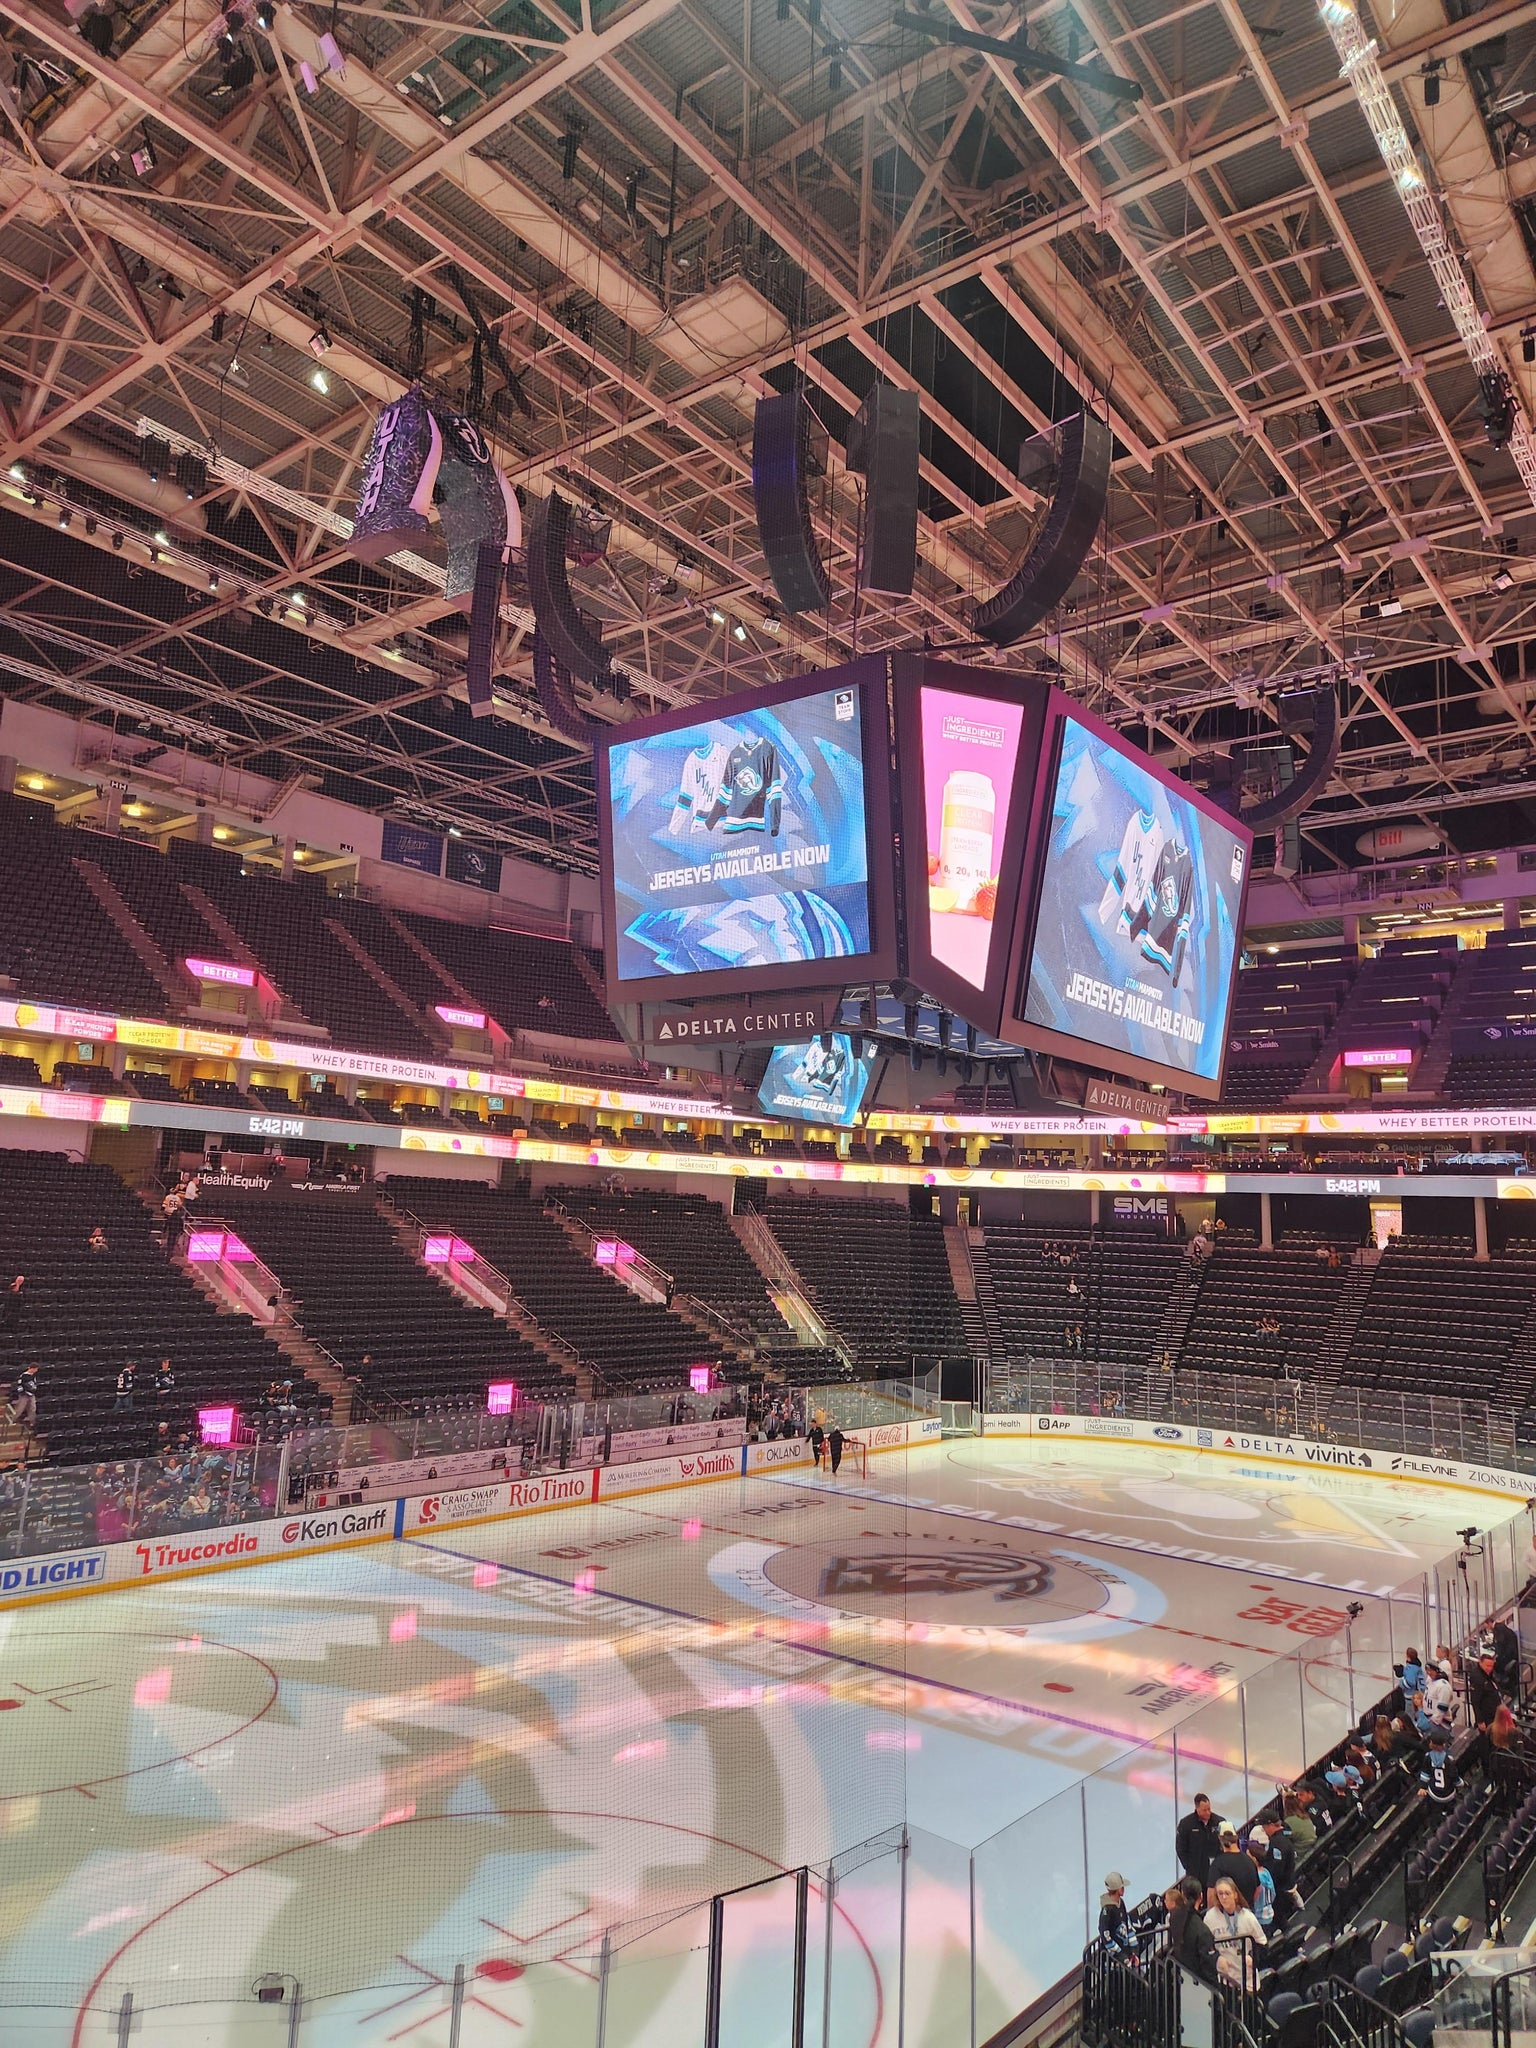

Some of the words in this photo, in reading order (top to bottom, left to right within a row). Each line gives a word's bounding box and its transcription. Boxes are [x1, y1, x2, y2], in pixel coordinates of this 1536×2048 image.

[947, 716, 965, 724] JUST
[946, 724, 1000, 740] INGREDIENTS
[1378, 830, 1402, 846] bill
[710, 851, 728, 861] UTAH
[727, 845, 760, 858] MAMMOTH
[649, 864, 712, 891] JERSEYS
[714, 850, 792, 880] AVAILABLE
[794, 844, 830, 868] NOW
[203, 966, 238, 980] BETTER
[1066, 972, 1124, 1014] JERSEYS
[1122, 989, 1181, 1035] AVAILABLE
[1178, 1016, 1205, 1045] NOW
[448, 1012, 474, 1024] BETTER
[678, 1018, 737, 1036] DELTA
[743, 1010, 816, 1031] CENTER
[312, 1053, 348, 1067] WHEY
[349, 1058, 388, 1074] BETTER
[1363, 1052, 1397, 1062] BETTER
[650, 1100, 676, 1110] WHEY
[678, 1104, 711, 1114] BETTER
[1100, 1090, 1132, 1110] DELTA
[1134, 1099, 1168, 1118] CENTER
[250, 1116, 281, 1134] 5:42
[282, 1120, 304, 1136] PM
[991, 1121, 1022, 1130] WHEY
[1023, 1122, 1060, 1130] BETTER
[1379, 1118, 1418, 1128] WHEY
[1420, 1118, 1468, 1128] BETTER
[678, 1162, 716, 1170] INGREDIENTS
[198, 1172, 272, 1190] HealthEquity
[1026, 1178, 1068, 1186] INGREDIENTS
[1326, 1179, 1359, 1193] 5:42
[1358, 1180, 1380, 1193] PM
[1114, 1198, 1168, 1214] SME
[1087, 1424, 1131, 1432] INGREDIENTS
[1154, 1428, 1182, 1439] Ford
[766, 1444, 800, 1461] OKLAND
[1241, 1438, 1294, 1455] DELTA
[1305, 1445, 1356, 1466] vivint
[696, 1454, 734, 1476] Smith's
[1403, 1461, 1458, 1478] FILEVINE
[1468, 1470, 1506, 1486] ZIONS
[442, 1494, 469, 1506] CRAIG
[470, 1488, 499, 1502] SWAPP
[508, 1484, 540, 1506] Rio
[540, 1478, 584, 1500] Tinto
[452, 1500, 492, 1512] ASSOCIATES
[300, 1519, 338, 1541] Ken
[341, 1508, 387, 1534] Garff
[588, 1530, 669, 1550] HEALTH
[894, 1532, 1008, 1548] DELTA
[156, 1532, 258, 1567] Trucordia
[26, 1558, 100, 1586] LIGHT
[1237, 1596, 1309, 1626] SEAT
[1434, 1767, 1445, 1789] 9
